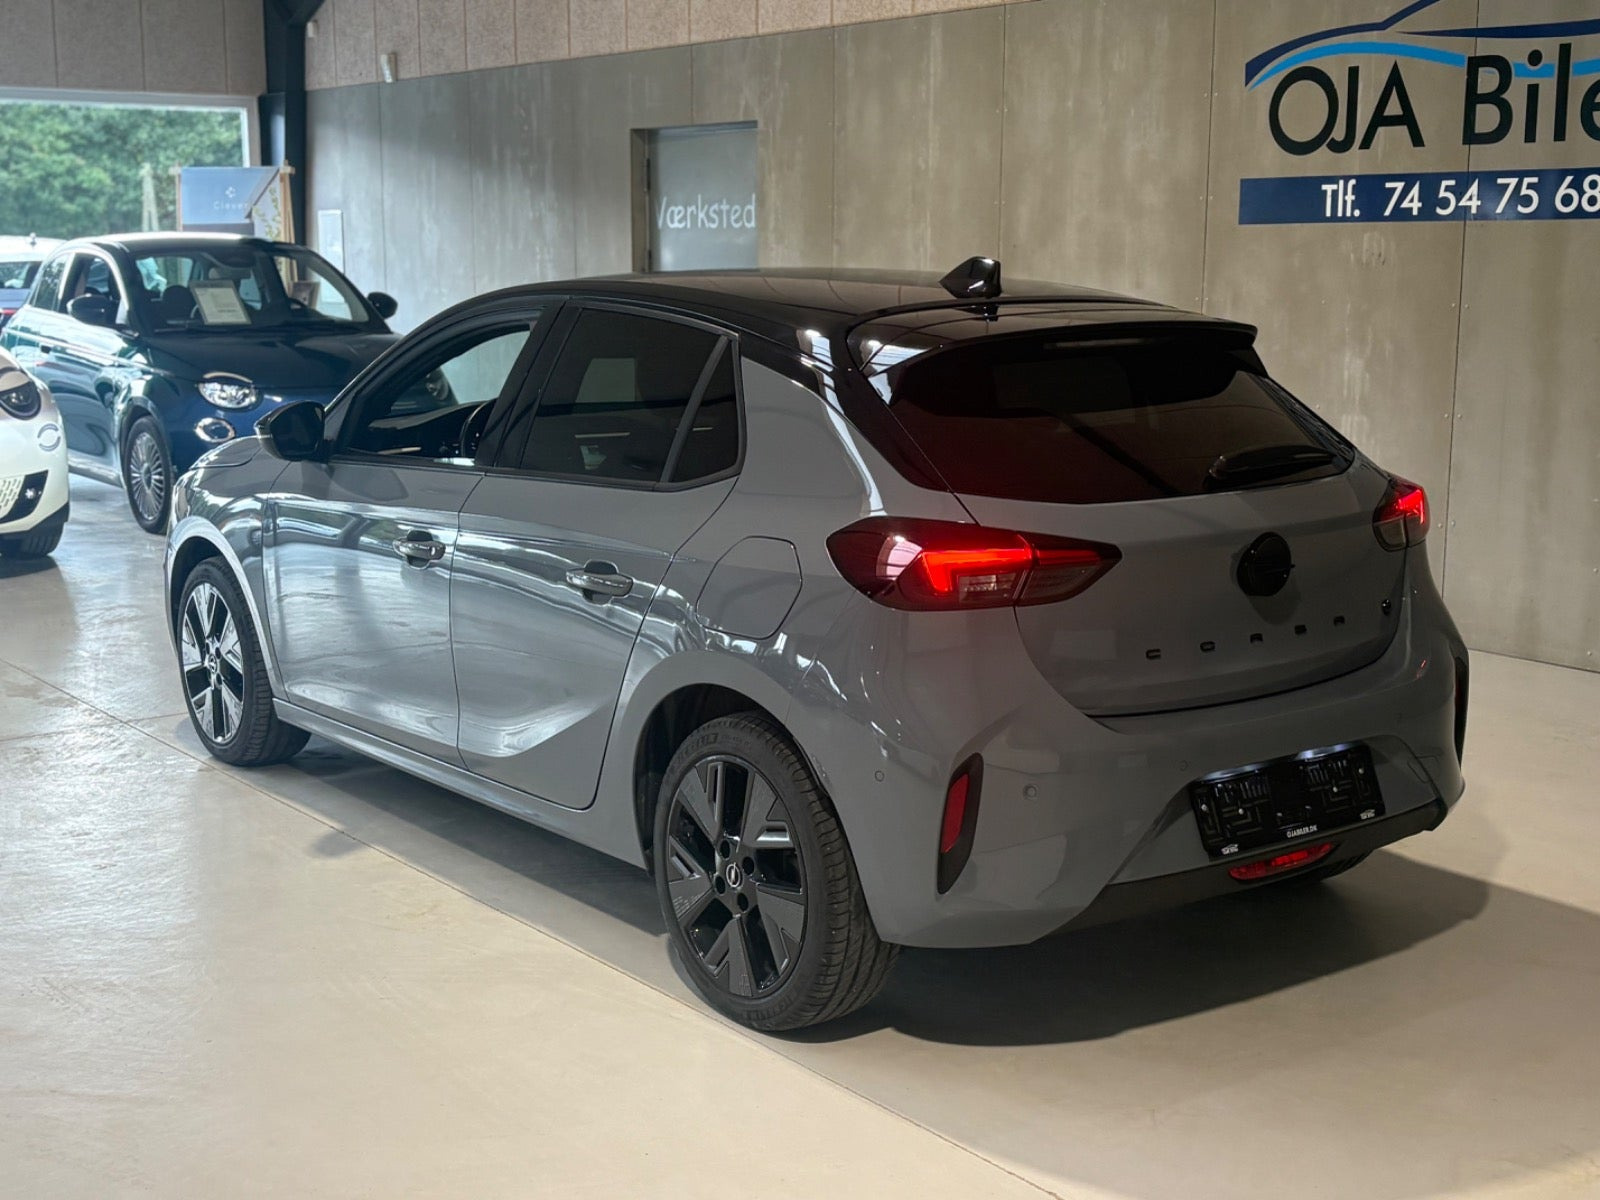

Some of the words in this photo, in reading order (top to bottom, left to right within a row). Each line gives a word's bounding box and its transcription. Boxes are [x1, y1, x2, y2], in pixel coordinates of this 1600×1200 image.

[1268, 59, 1426, 156] OJA
[656, 192, 756, 229] Værksted
[1321, 178, 1361, 218] Tlf.
[1384, 180, 1423, 217] 74
[1435, 178, 1481, 217] 54
[1495, 176, 1540, 215] 75
[1554, 174, 1600, 214] 68
